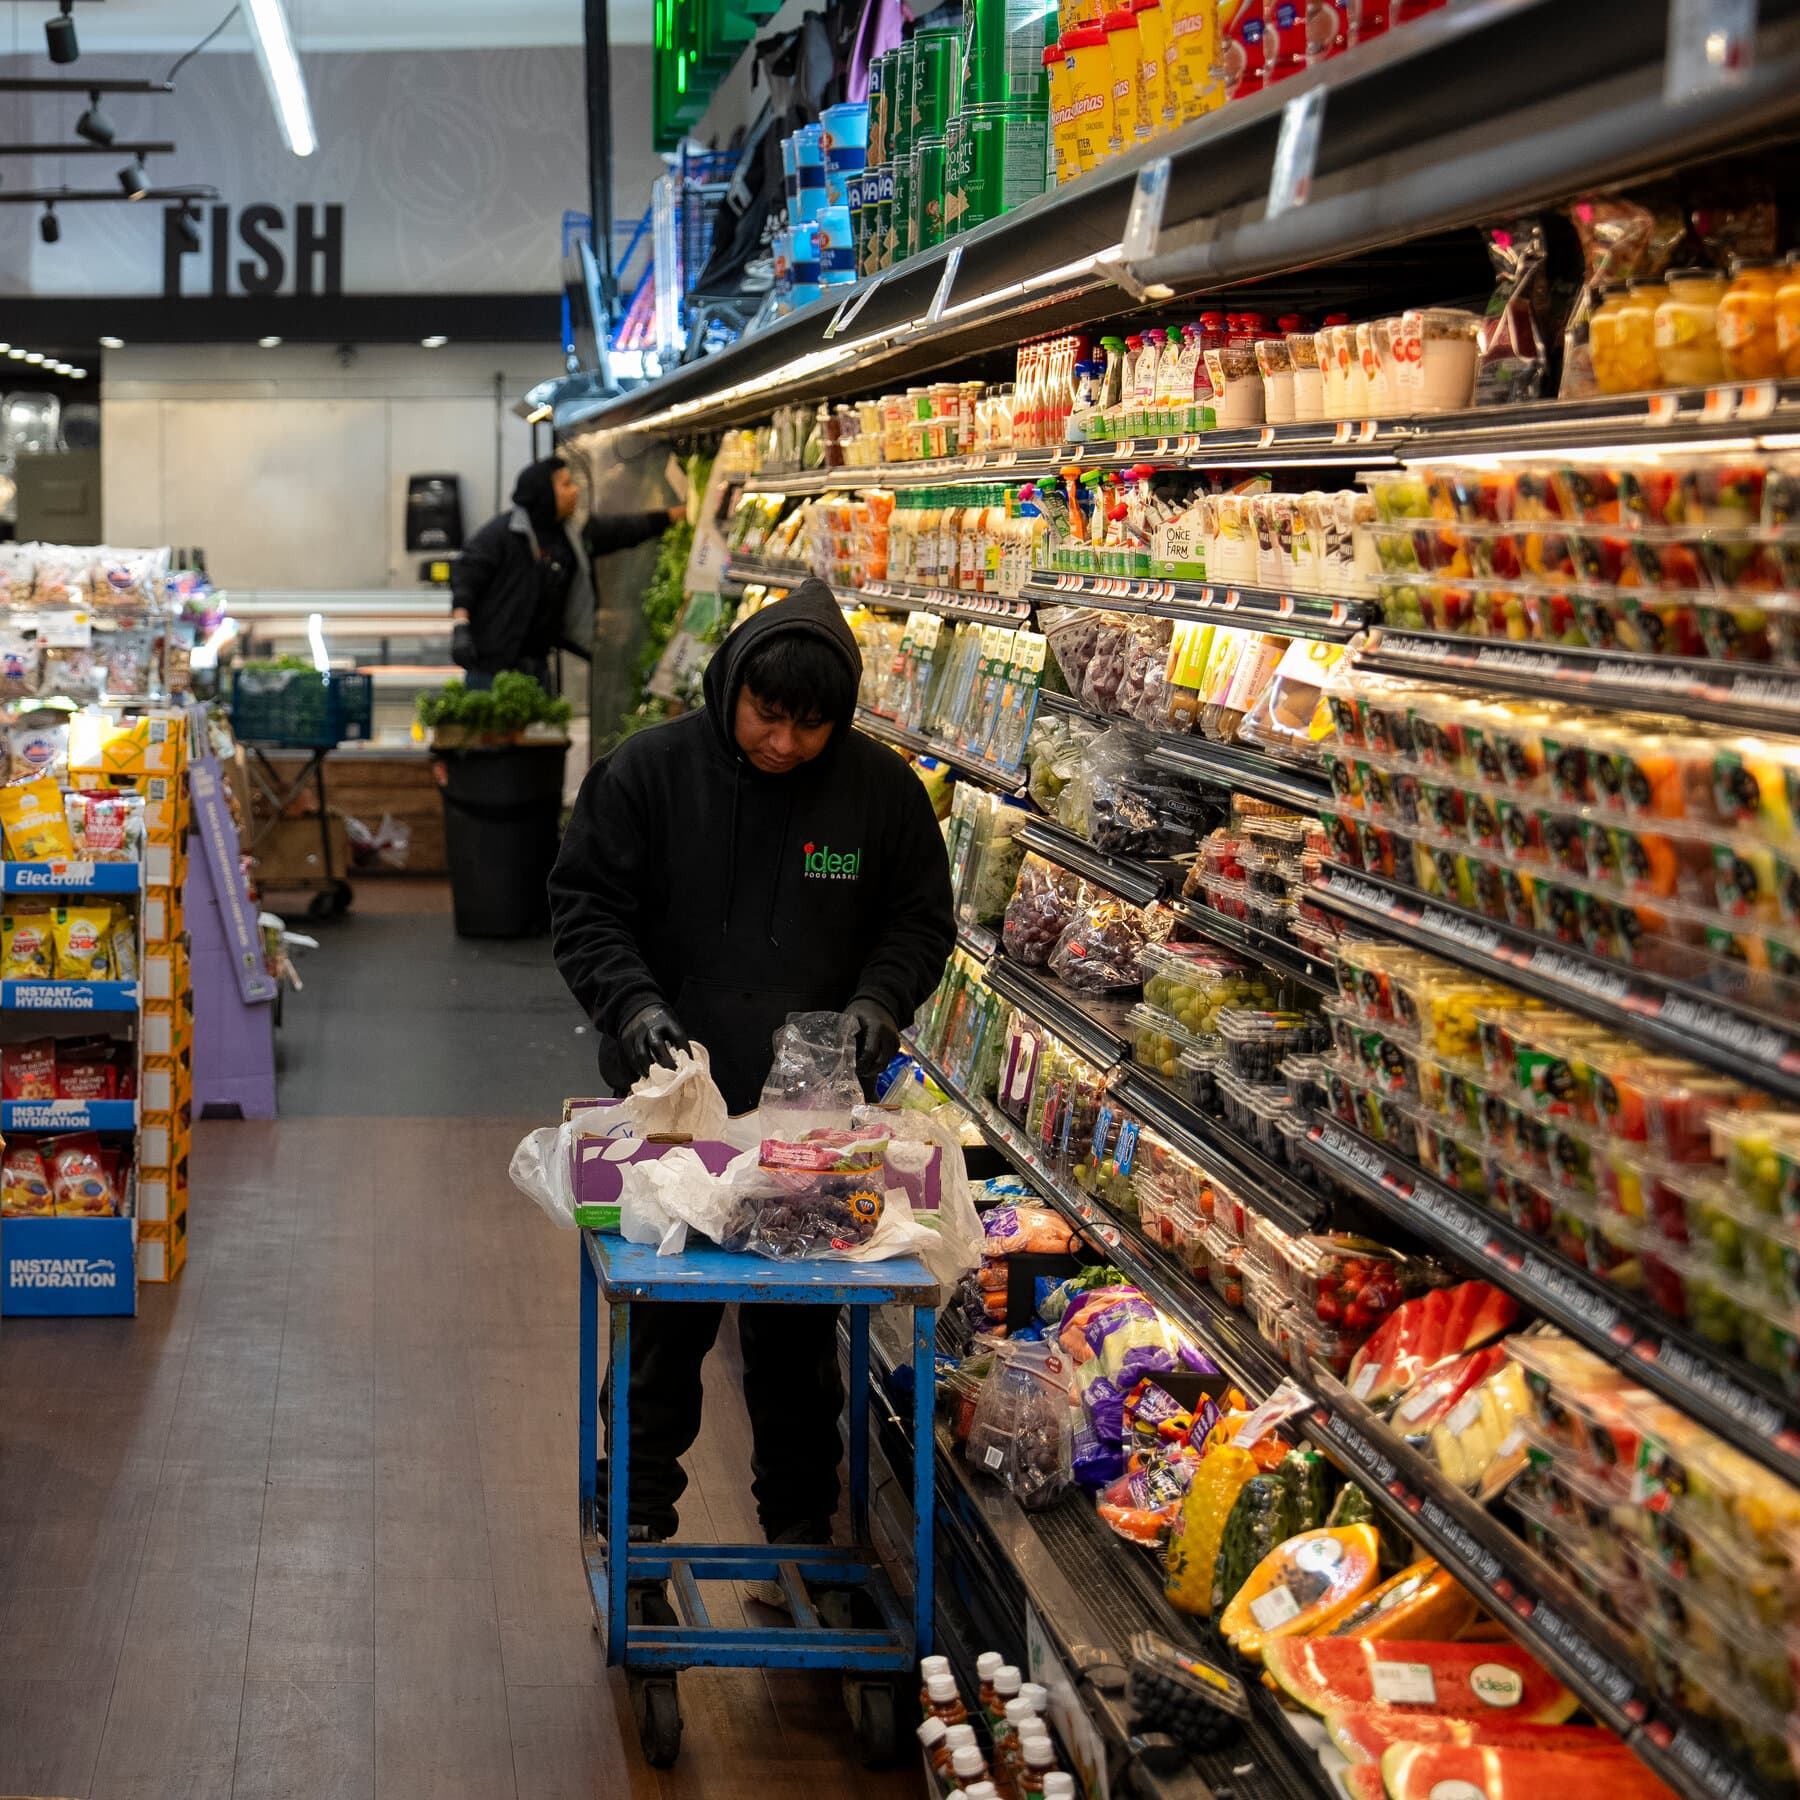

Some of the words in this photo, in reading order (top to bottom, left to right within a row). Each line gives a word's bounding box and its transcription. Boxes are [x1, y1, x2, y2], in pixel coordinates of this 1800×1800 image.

[164, 205, 343, 296] FISH
[1166, 528, 1191, 541] ONCE
[1166, 541, 1189, 559] FARM
[803, 842, 862, 874] ideal
[804, 871, 827, 879] FOOD
[15, 986, 73, 997] INSTANT
[15, 997, 94, 1008] HYDRATION
[12, 1116, 90, 1127] HYDRATION
[10, 1259, 88, 1273] INSTANT
[10, 1273, 115, 1287] HYDRATION
[1475, 1675, 1518, 1693] ideal
